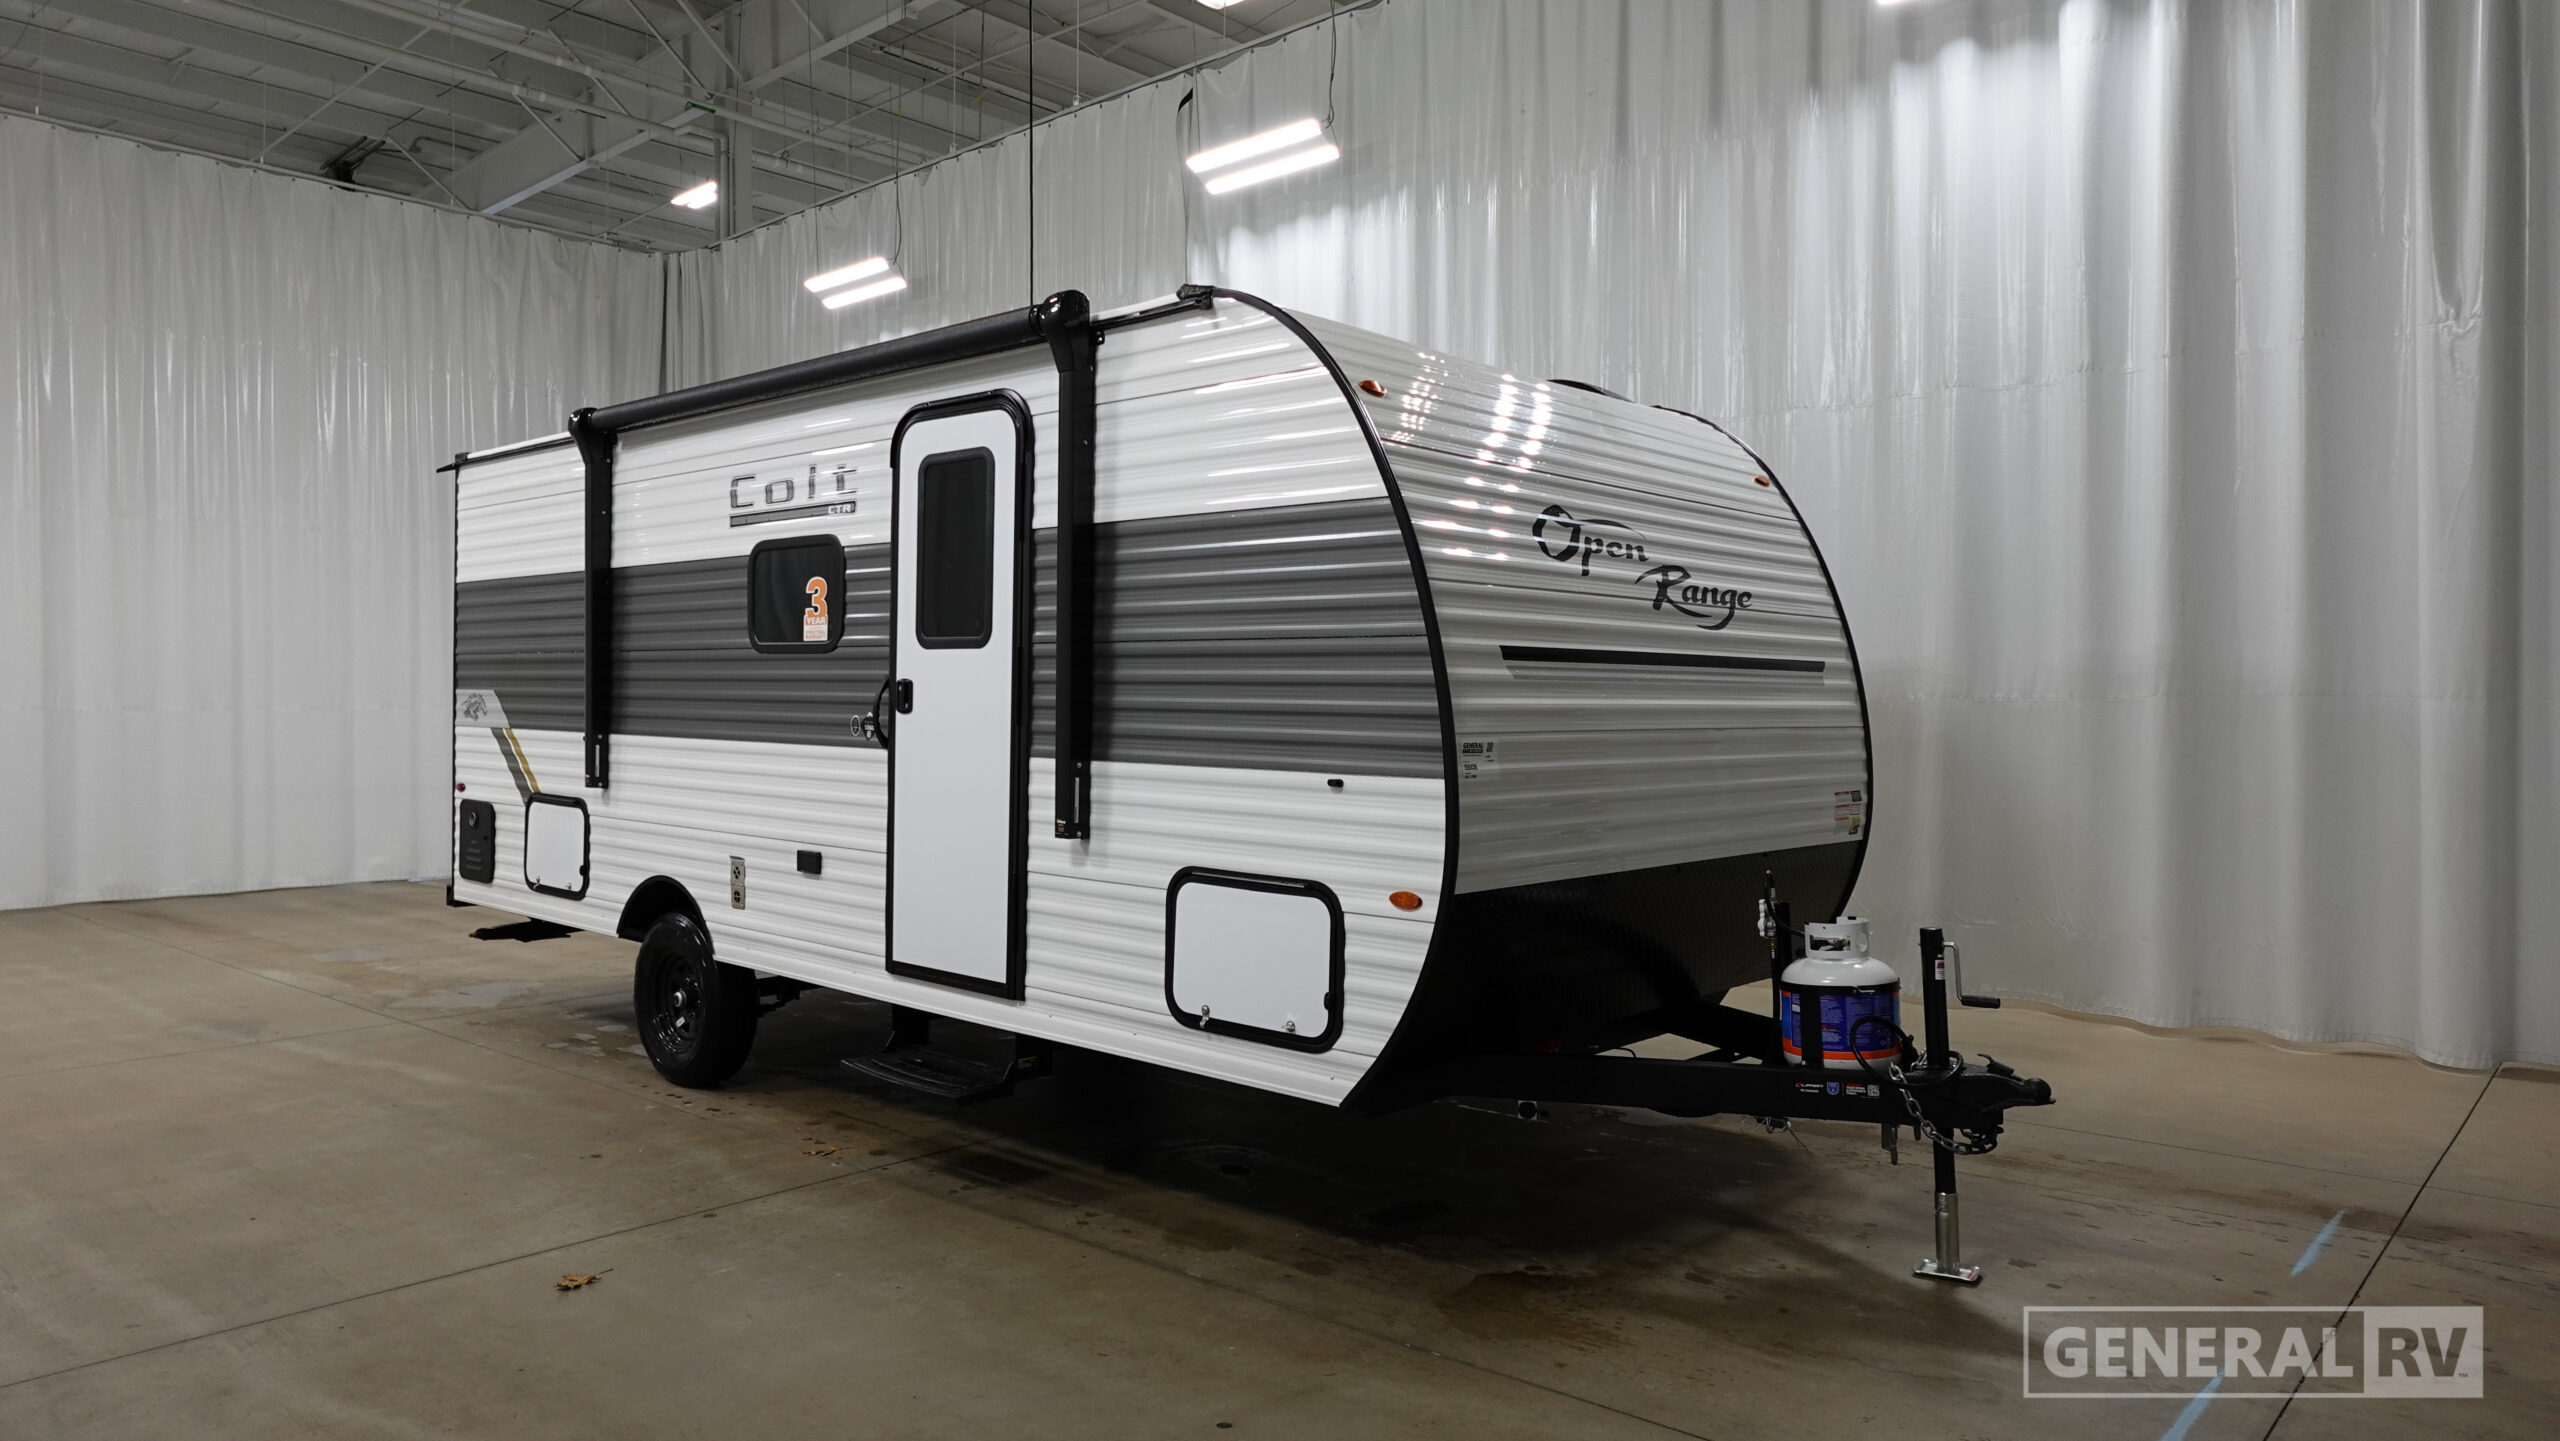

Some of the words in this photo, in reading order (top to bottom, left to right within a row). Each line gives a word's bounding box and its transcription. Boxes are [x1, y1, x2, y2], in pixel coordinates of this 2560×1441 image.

[729, 464, 857, 508] Colt
[828, 504, 852, 515] CTR
[1532, 504, 1650, 577] Open
[805, 576, 828, 618] 3
[1634, 565, 1753, 631] Range
[807, 617, 826, 625] YEAR
